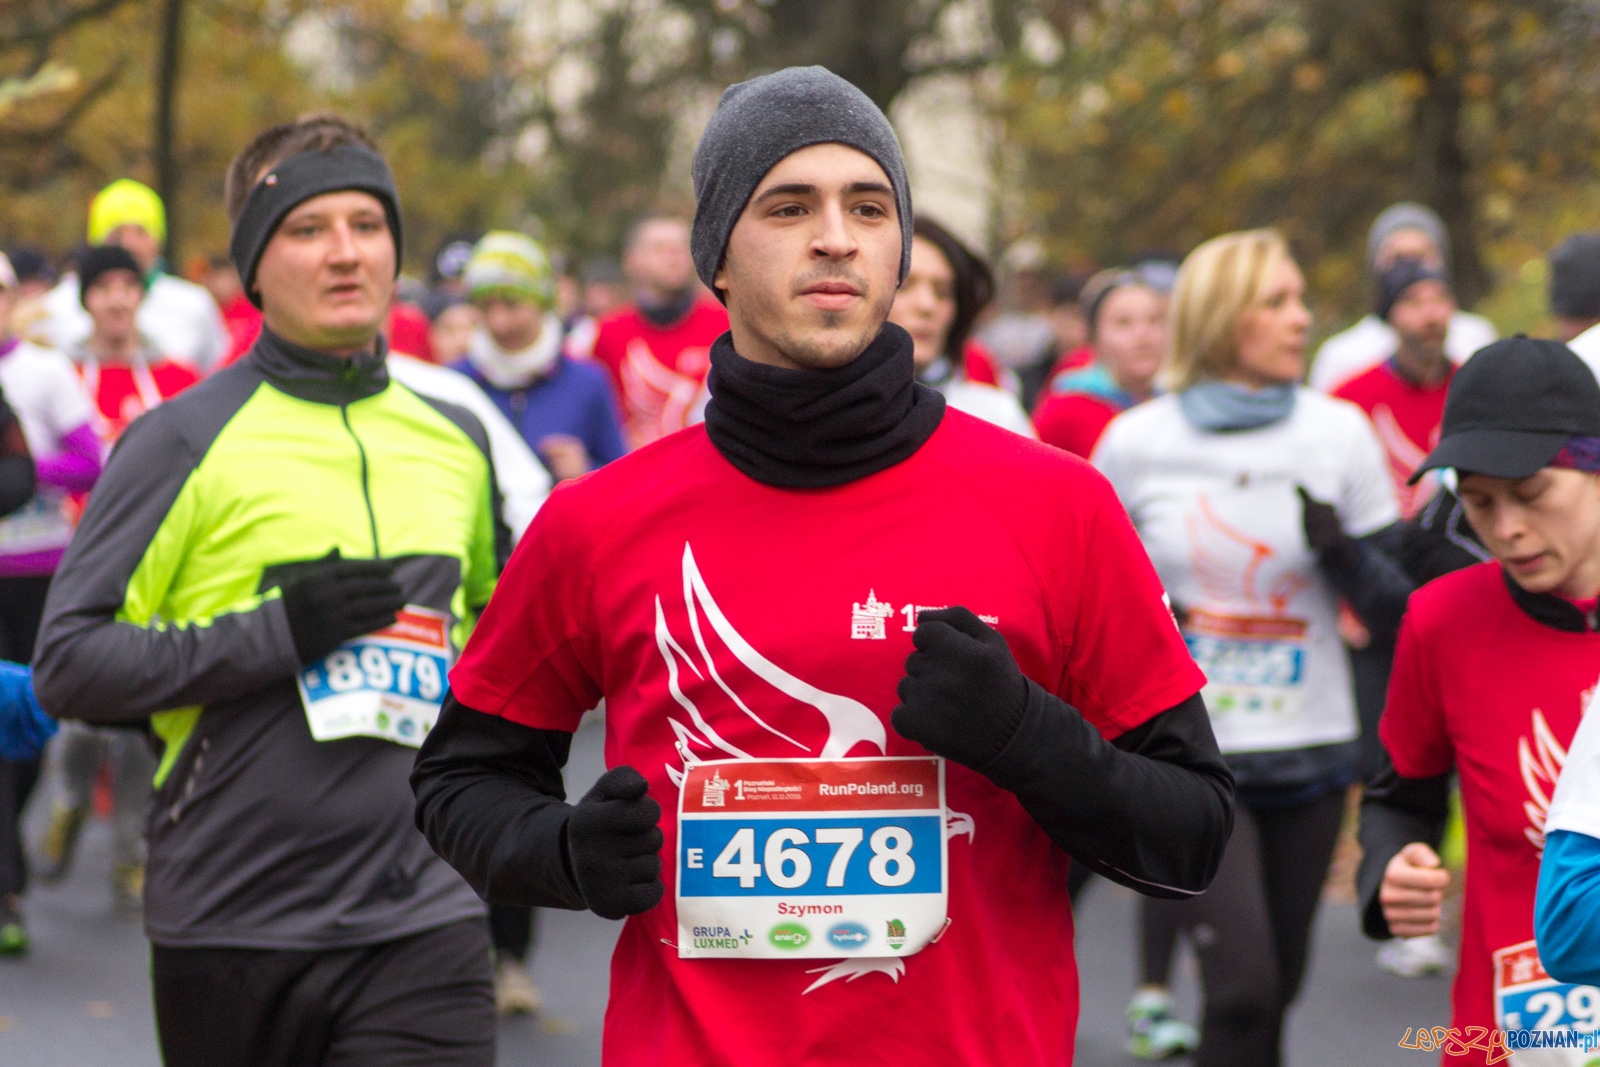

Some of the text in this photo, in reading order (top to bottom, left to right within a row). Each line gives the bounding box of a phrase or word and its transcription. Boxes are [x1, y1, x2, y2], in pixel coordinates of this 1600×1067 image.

[900, 604, 916, 632] 1
[324, 645, 442, 700] 8979
[734, 779, 745, 800] 1
[819, 781, 924, 797] RunPoland.org
[687, 825, 917, 889] E 4678
[777, 902, 844, 918] Szymon
[693, 926, 732, 938] GRUPA
[694, 938, 739, 949] LUXMED
